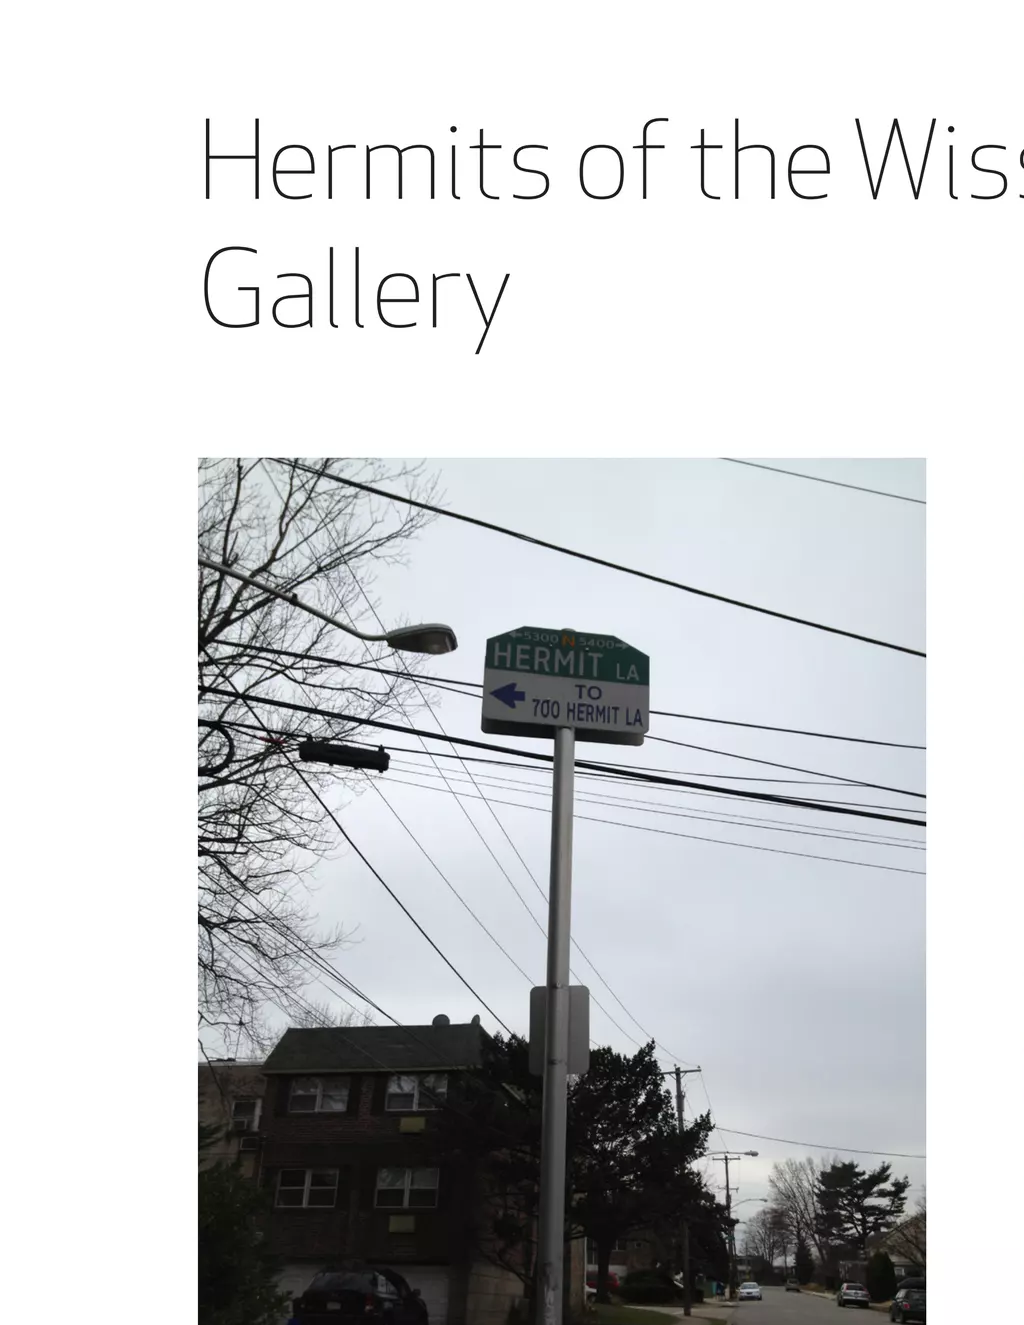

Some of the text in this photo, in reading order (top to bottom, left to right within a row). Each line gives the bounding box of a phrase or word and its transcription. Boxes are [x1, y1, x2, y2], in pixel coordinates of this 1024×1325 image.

[523, 632, 559, 644] 5300
[579, 637, 615, 649] 5400
[493, 642, 640, 681] HERMIT LA
[575, 685, 602, 700] TO
[532, 699, 643, 727] 700 HERMIT LA
